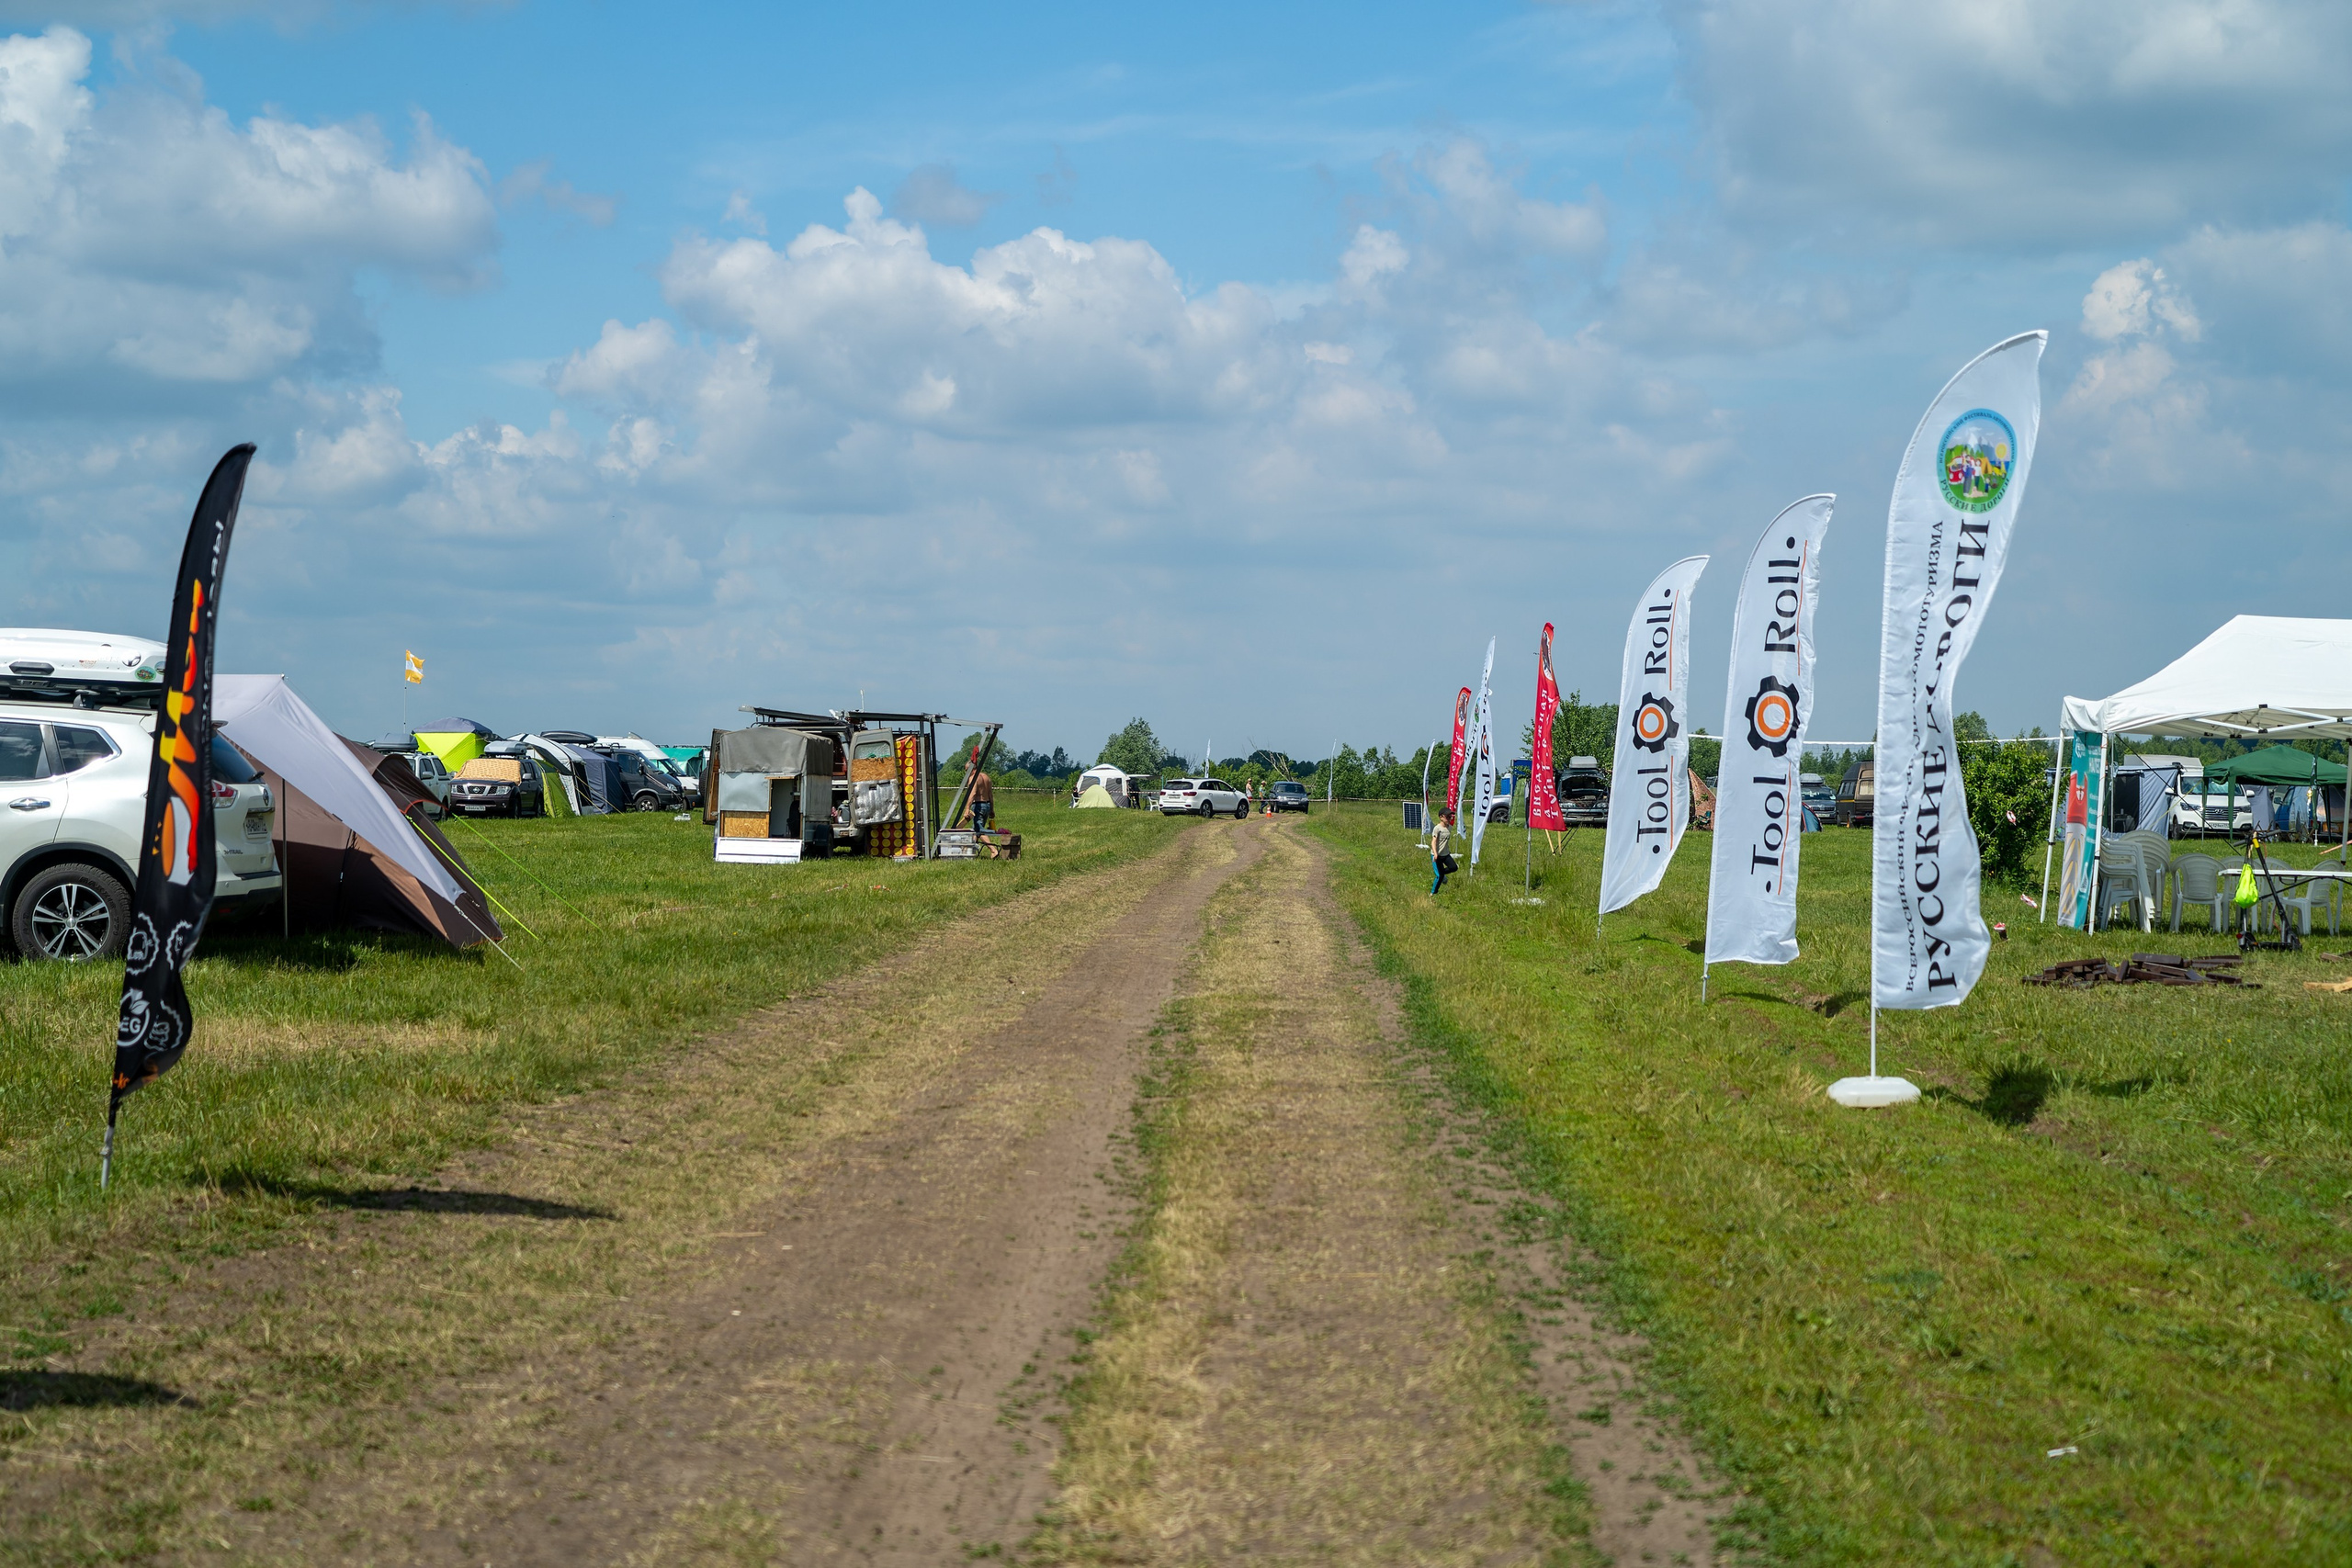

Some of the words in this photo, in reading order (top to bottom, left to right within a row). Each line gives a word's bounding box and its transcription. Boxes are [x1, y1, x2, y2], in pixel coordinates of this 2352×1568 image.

[1644, 602, 1673, 675] Roll
[1764, 556, 1801, 653] Roll
[1636, 764, 1669, 843] Tool
[1751, 773, 1787, 875] Tool
[1897, 829, 1917, 993] ВСЕРОССИЙСКИЙ
[1914, 745, 1958, 992] РУССКИЕ
[119, 1016, 141, 1034] EG
